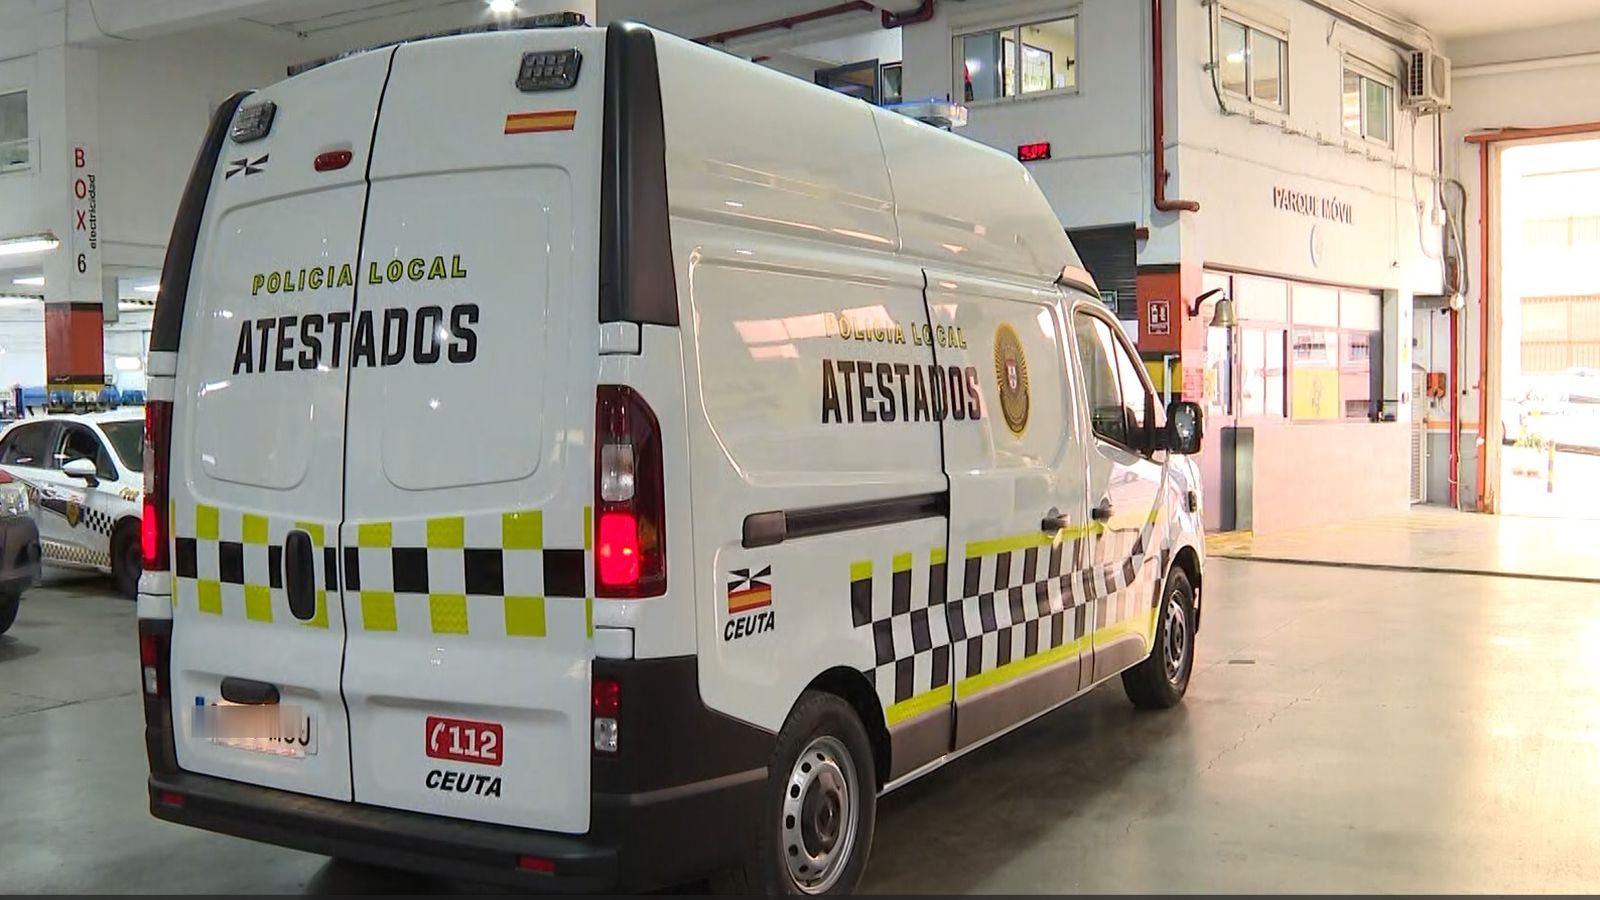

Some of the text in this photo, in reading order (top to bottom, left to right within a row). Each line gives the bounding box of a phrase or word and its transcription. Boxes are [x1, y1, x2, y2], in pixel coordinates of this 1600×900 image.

[87, 174, 97, 249] electricidad
[1273, 186, 1319, 217] PARQUE
[77, 253, 87, 274] 6
[252, 254, 468, 295] POLICIA LOCAL
[232, 303, 480, 375] ATESTADOS
[824, 312, 967, 349] POLICIA LOCAL
[821, 359, 982, 424] ATESTADOS
[724, 611, 775, 642] CEUTA
[449, 726, 497, 760] 112
[425, 769, 502, 798] CEUTA
